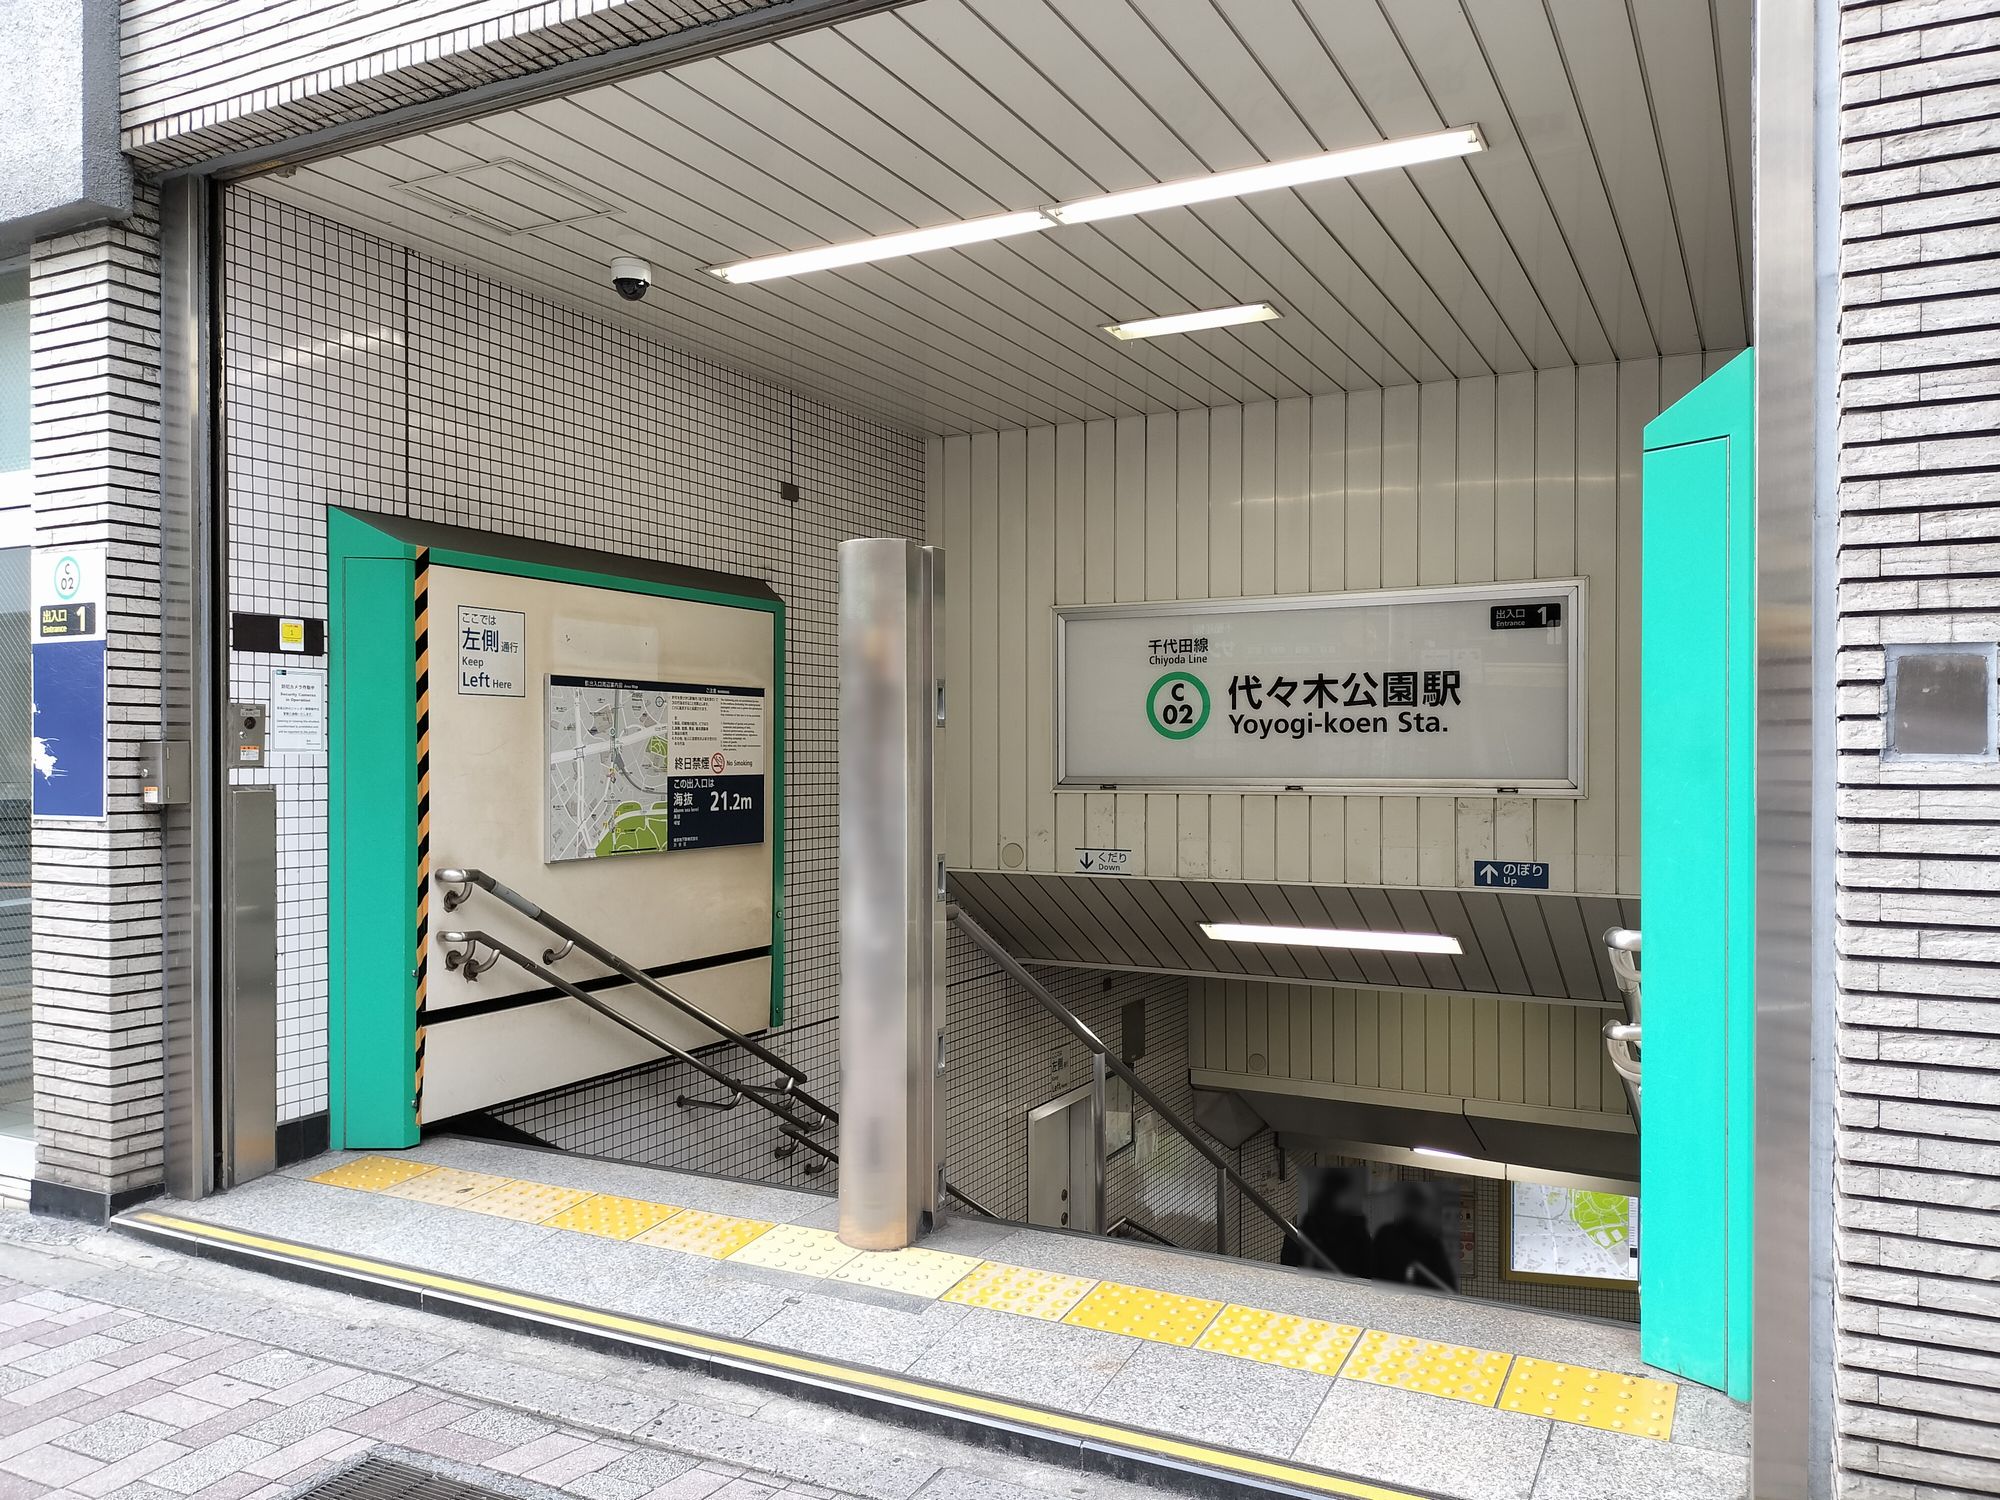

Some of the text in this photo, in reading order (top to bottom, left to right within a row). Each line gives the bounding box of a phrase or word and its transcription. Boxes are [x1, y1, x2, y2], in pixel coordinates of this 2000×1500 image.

[64, 563, 71, 575] C
[61, 577, 74, 590] 02
[42, 606, 86, 632] 出入口 1
[462, 613, 497, 626] ここでは
[1495, 606, 1548, 625] 出入口 1
[42, 624, 68, 634] Entrance
[1495, 619, 1526, 627] Entrance
[1148, 637, 1209, 655] 千代田線
[462, 656, 484, 669] Keep
[1149, 653, 1208, 666] Chiyoda Line
[462, 671, 512, 689] Left Here
[1170, 682, 1185, 702] C
[1228, 670, 1462, 710] 代々木公園駅
[1162, 704, 1193, 725] 02
[1228, 711, 1449, 739] Yoyogi-koen Sta.
[674, 756, 710, 770] 終日禁煙
[733, 758, 753, 768] Smoking
[673, 778, 715, 789] この出入口は
[673, 791, 694, 807] 海抜
[710, 790, 752, 812] 21.2m
[1097, 850, 1127, 864] くだり
[1098, 863, 1121, 872] Down
[1503, 862, 1543, 877] のぼり
[1503, 876, 1518, 887] Up
